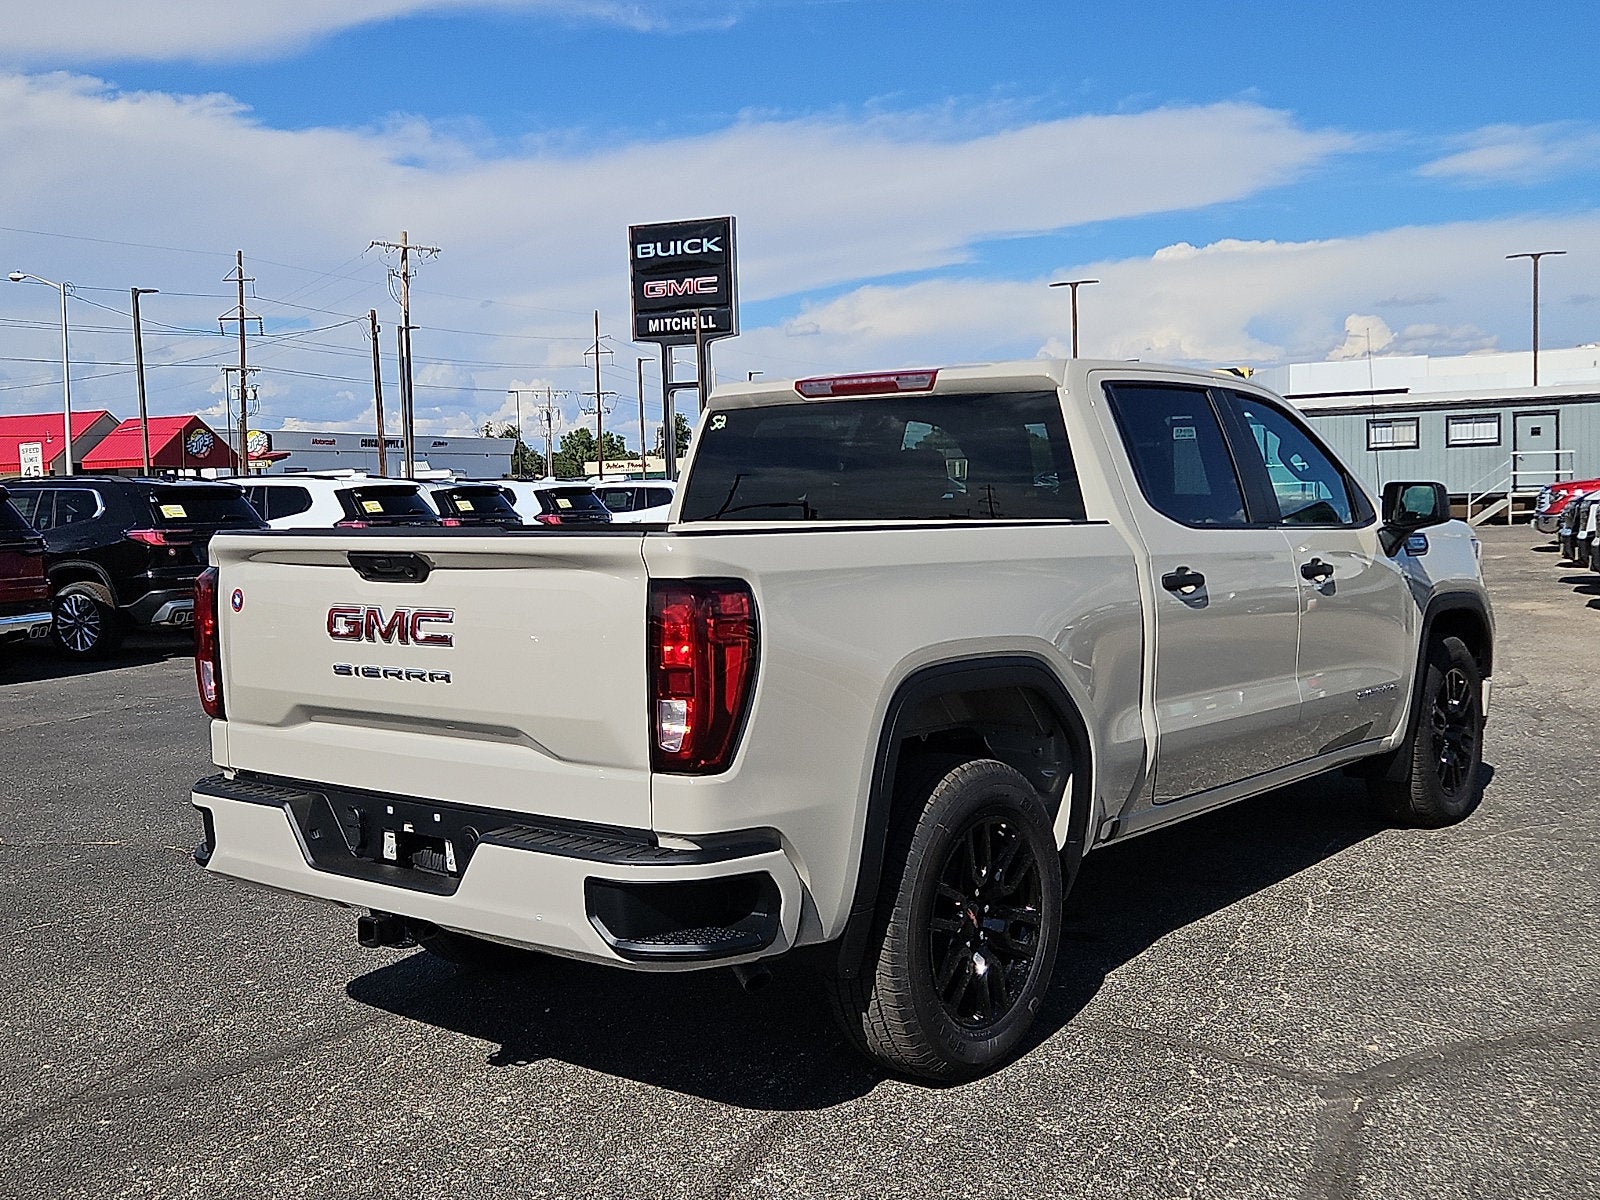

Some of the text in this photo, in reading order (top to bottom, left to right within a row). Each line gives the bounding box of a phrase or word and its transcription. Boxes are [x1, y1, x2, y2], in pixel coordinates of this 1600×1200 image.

[636, 237, 723, 259] BUICK
[643, 276, 718, 298] GMC
[648, 315, 717, 332] MITCHELL
[24, 465, 41, 477] 45
[327, 604, 455, 648] GMC
[332, 663, 452, 684] SIERRA
